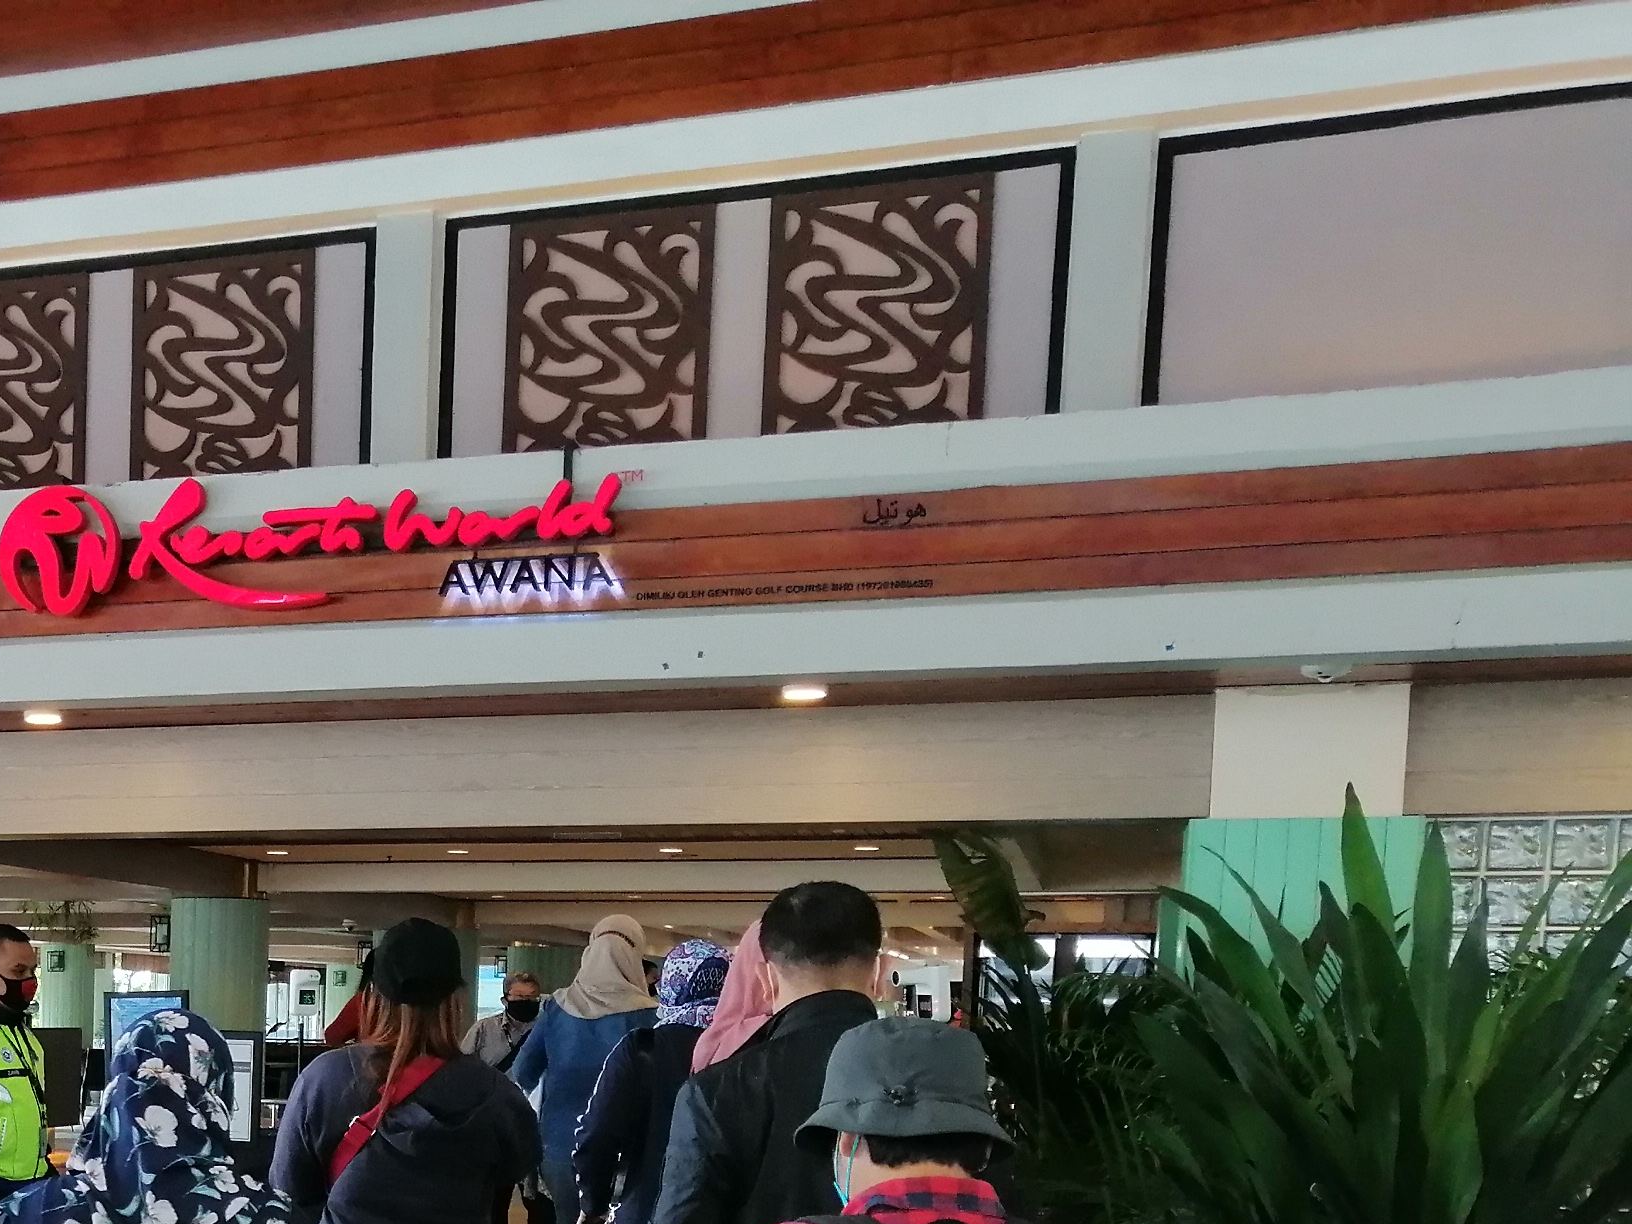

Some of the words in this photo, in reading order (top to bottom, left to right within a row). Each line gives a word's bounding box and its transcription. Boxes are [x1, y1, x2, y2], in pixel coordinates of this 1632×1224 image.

[438, 552, 615, 597] AWANA
[707, 587, 753, 597] GENTING
[755, 585, 783, 595] GOLF
[785, 582, 829, 594] COURSE
